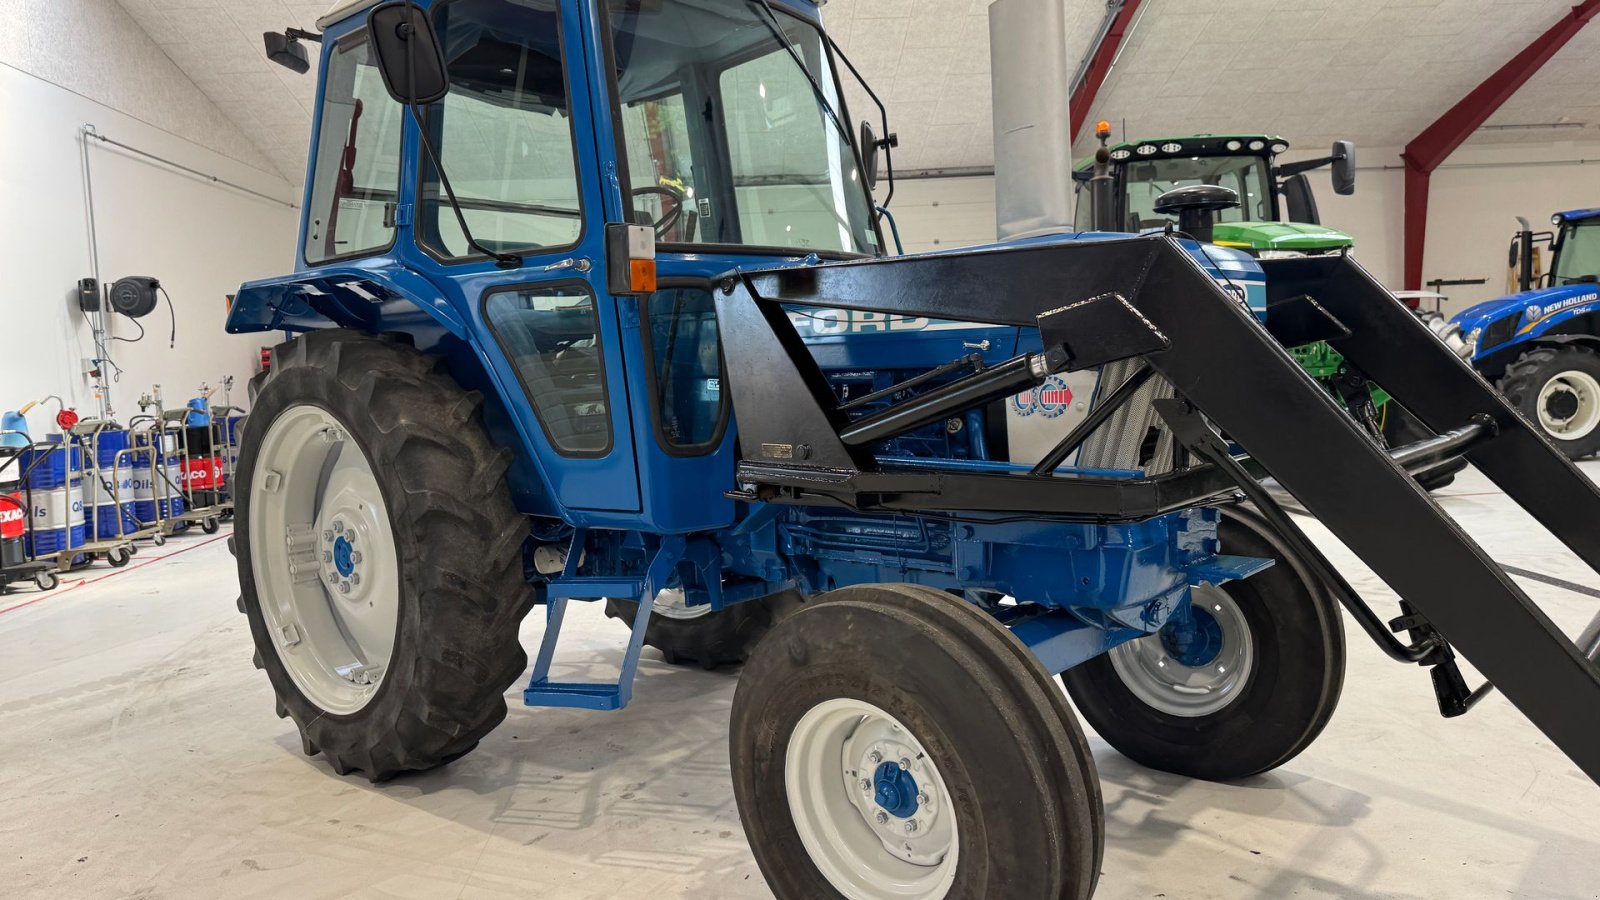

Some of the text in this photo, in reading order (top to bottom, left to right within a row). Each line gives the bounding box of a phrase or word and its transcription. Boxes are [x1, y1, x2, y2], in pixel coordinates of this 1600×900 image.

[1543, 293, 1597, 315] NEW HOLLAND
[787, 309, 929, 334] FORD
